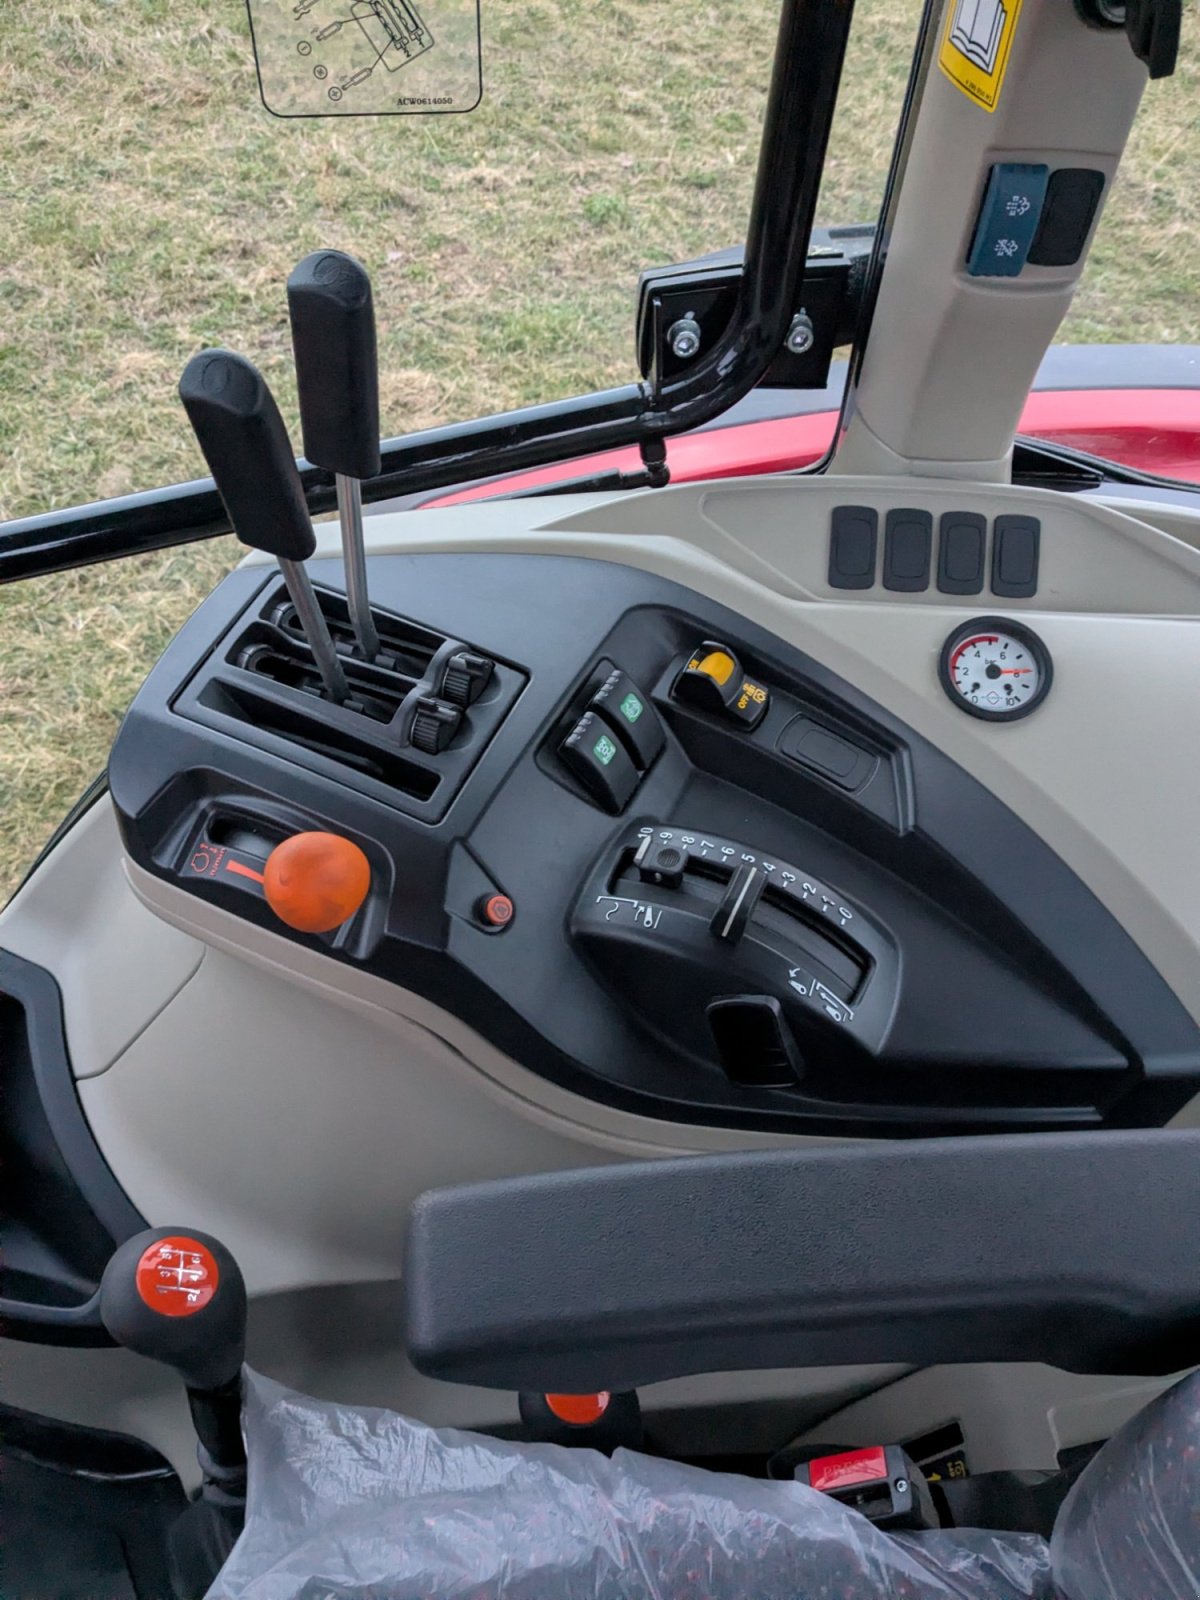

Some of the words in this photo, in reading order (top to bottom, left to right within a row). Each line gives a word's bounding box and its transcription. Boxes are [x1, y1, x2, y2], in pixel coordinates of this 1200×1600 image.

[974, 650, 981, 658] 4
[1000, 652, 1006, 660] 6
[962, 667, 969, 676] 2
[737, 693, 750, 709] OFF
[972, 695, 978, 704] 0
[1006, 698, 1015, 706] 10
[637, 827, 654, 839] 10
[659, 831, 673, 840] 9
[681, 836, 695, 844] 8
[700, 840, 715, 849] 7
[721, 846, 736, 856] 6
[741, 853, 756, 864] 5
[762, 862, 777, 872] 4
[782, 871, 796, 882] 3
[802, 882, 817, 895] 2
[821, 895, 836, 906] 1
[839, 907, 853, 920] 0
[187, 1293, 197, 1302] 2
